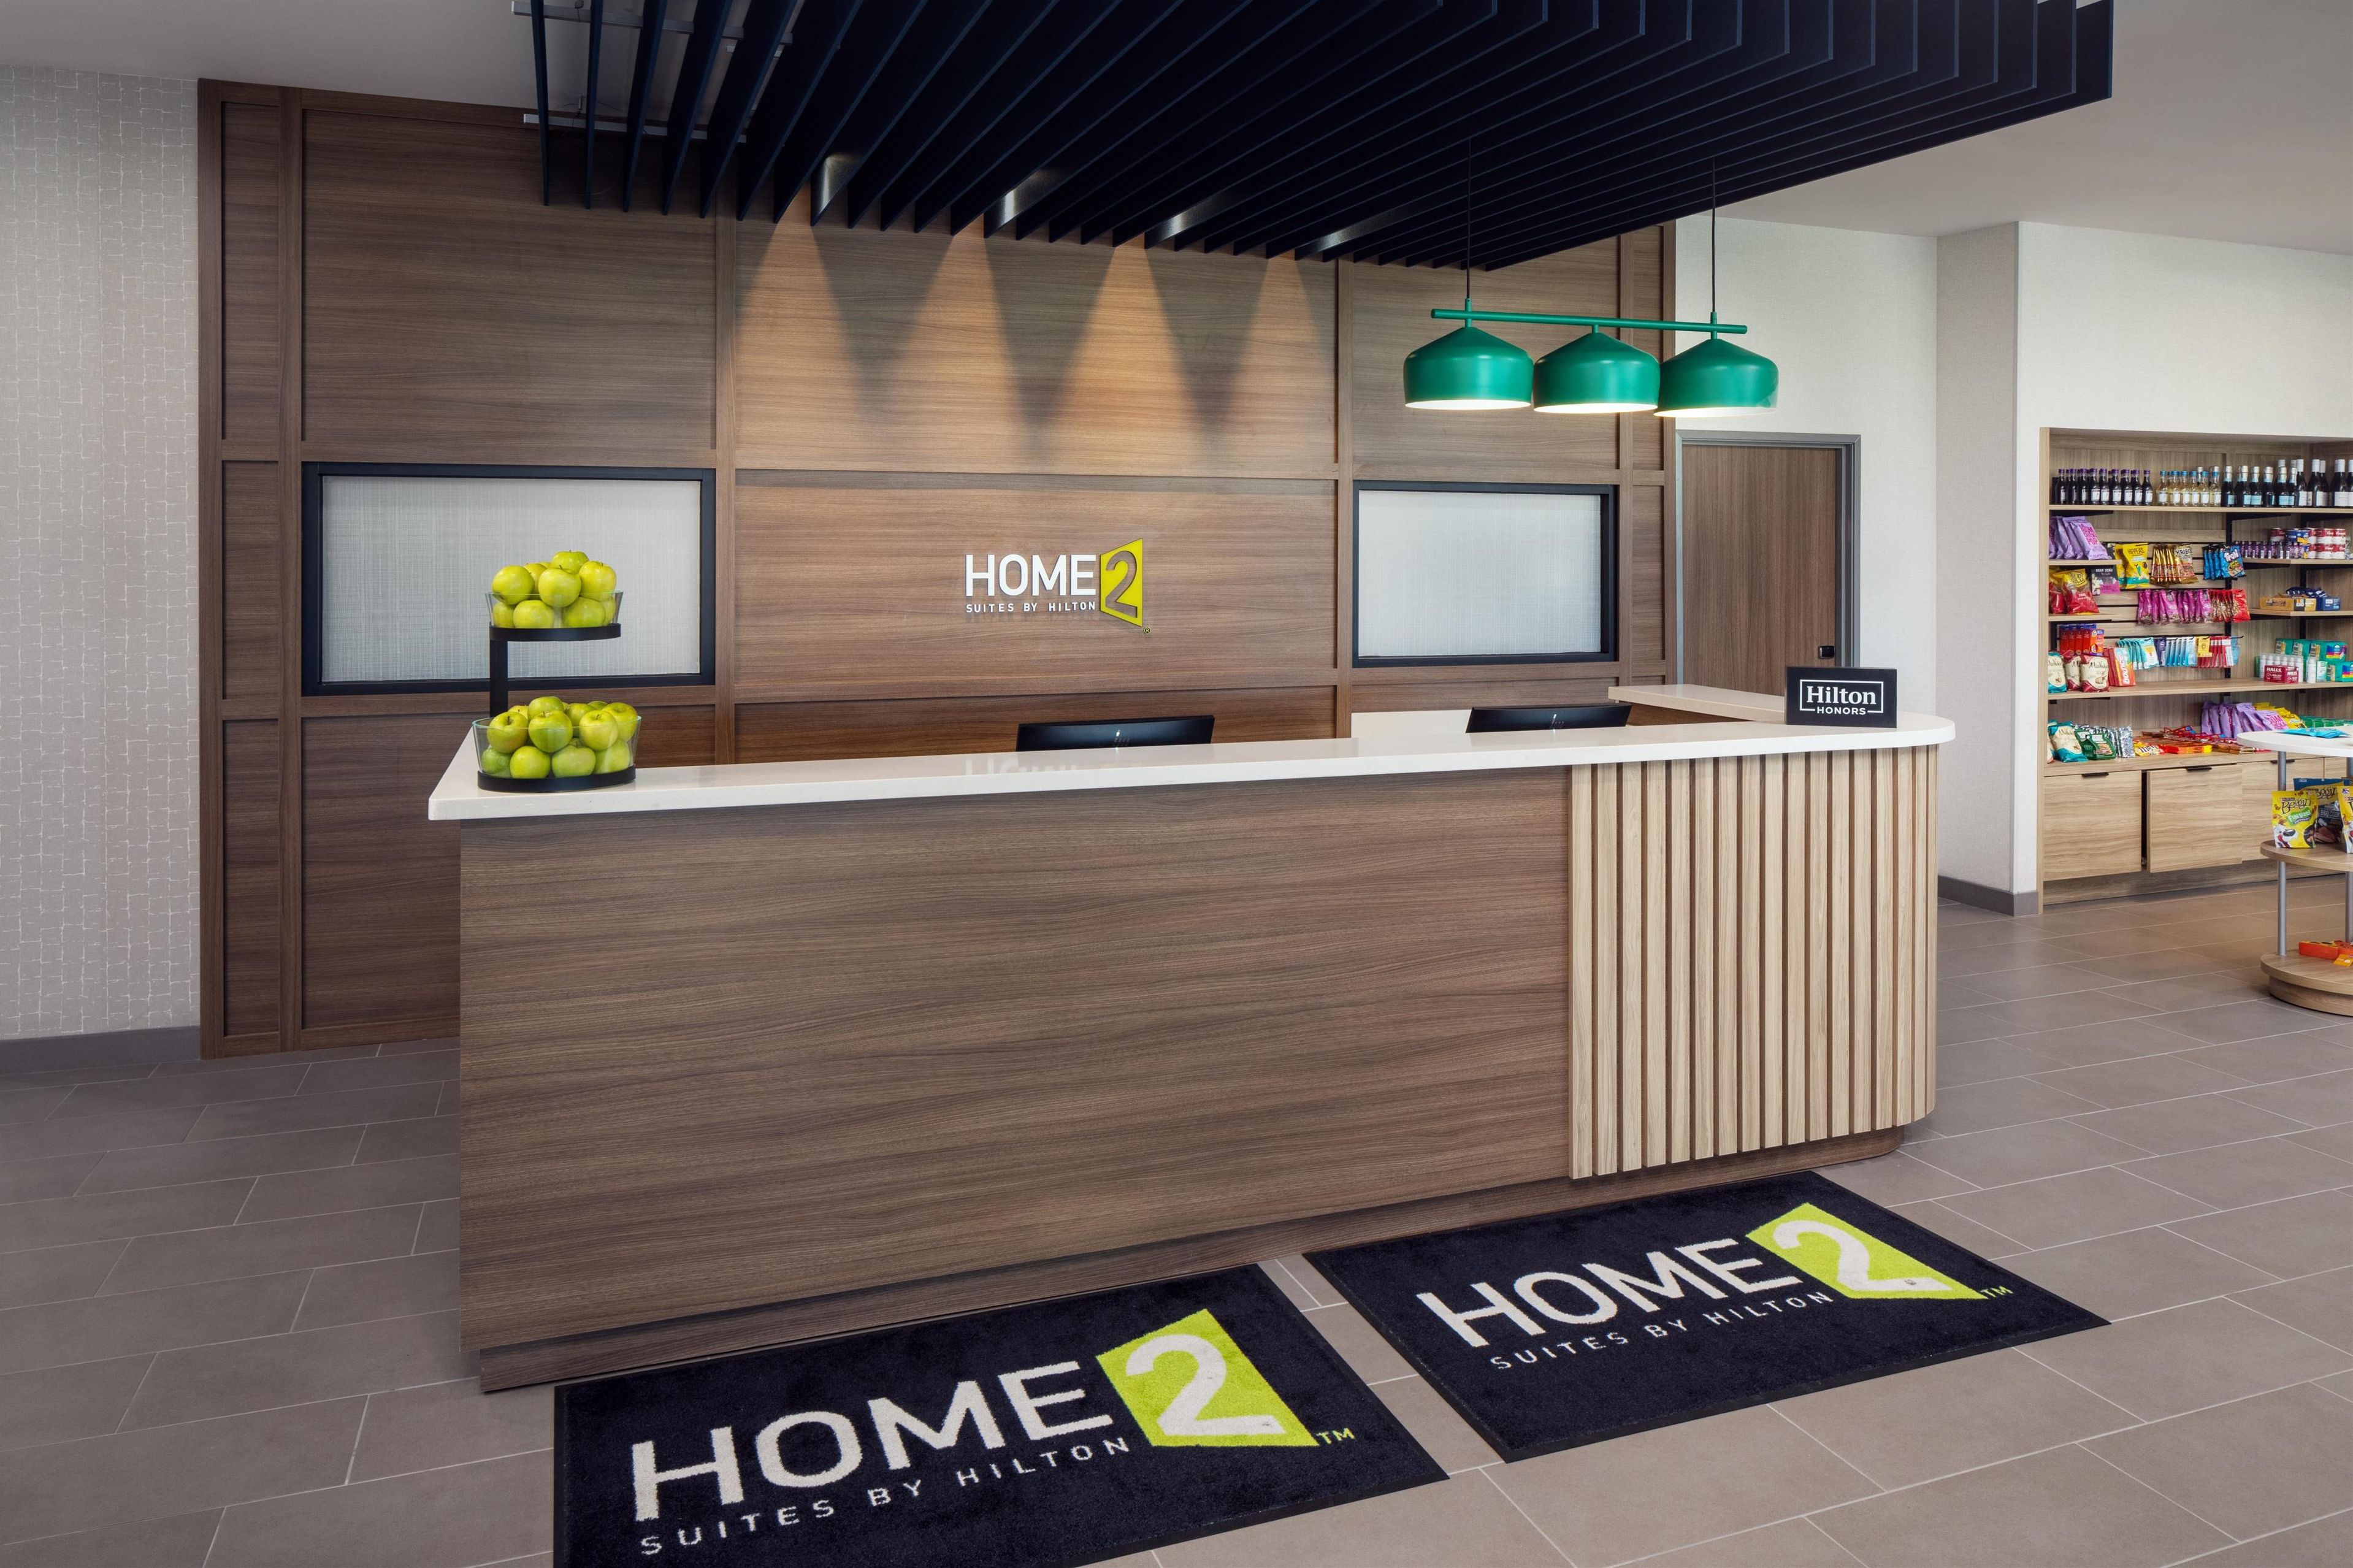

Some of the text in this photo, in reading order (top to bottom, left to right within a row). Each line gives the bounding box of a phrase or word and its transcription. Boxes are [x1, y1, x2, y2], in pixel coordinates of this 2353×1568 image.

[966, 601, 1096, 613] SUITES BY HILTON
[1807, 686, 1877, 705] Hilton
[1817, 706, 1866, 715] HONORS
[1491, 1291, 1834, 1369] SUITES BY HILTON
[640, 1437, 1130, 1556] SUITES BY HILTON
